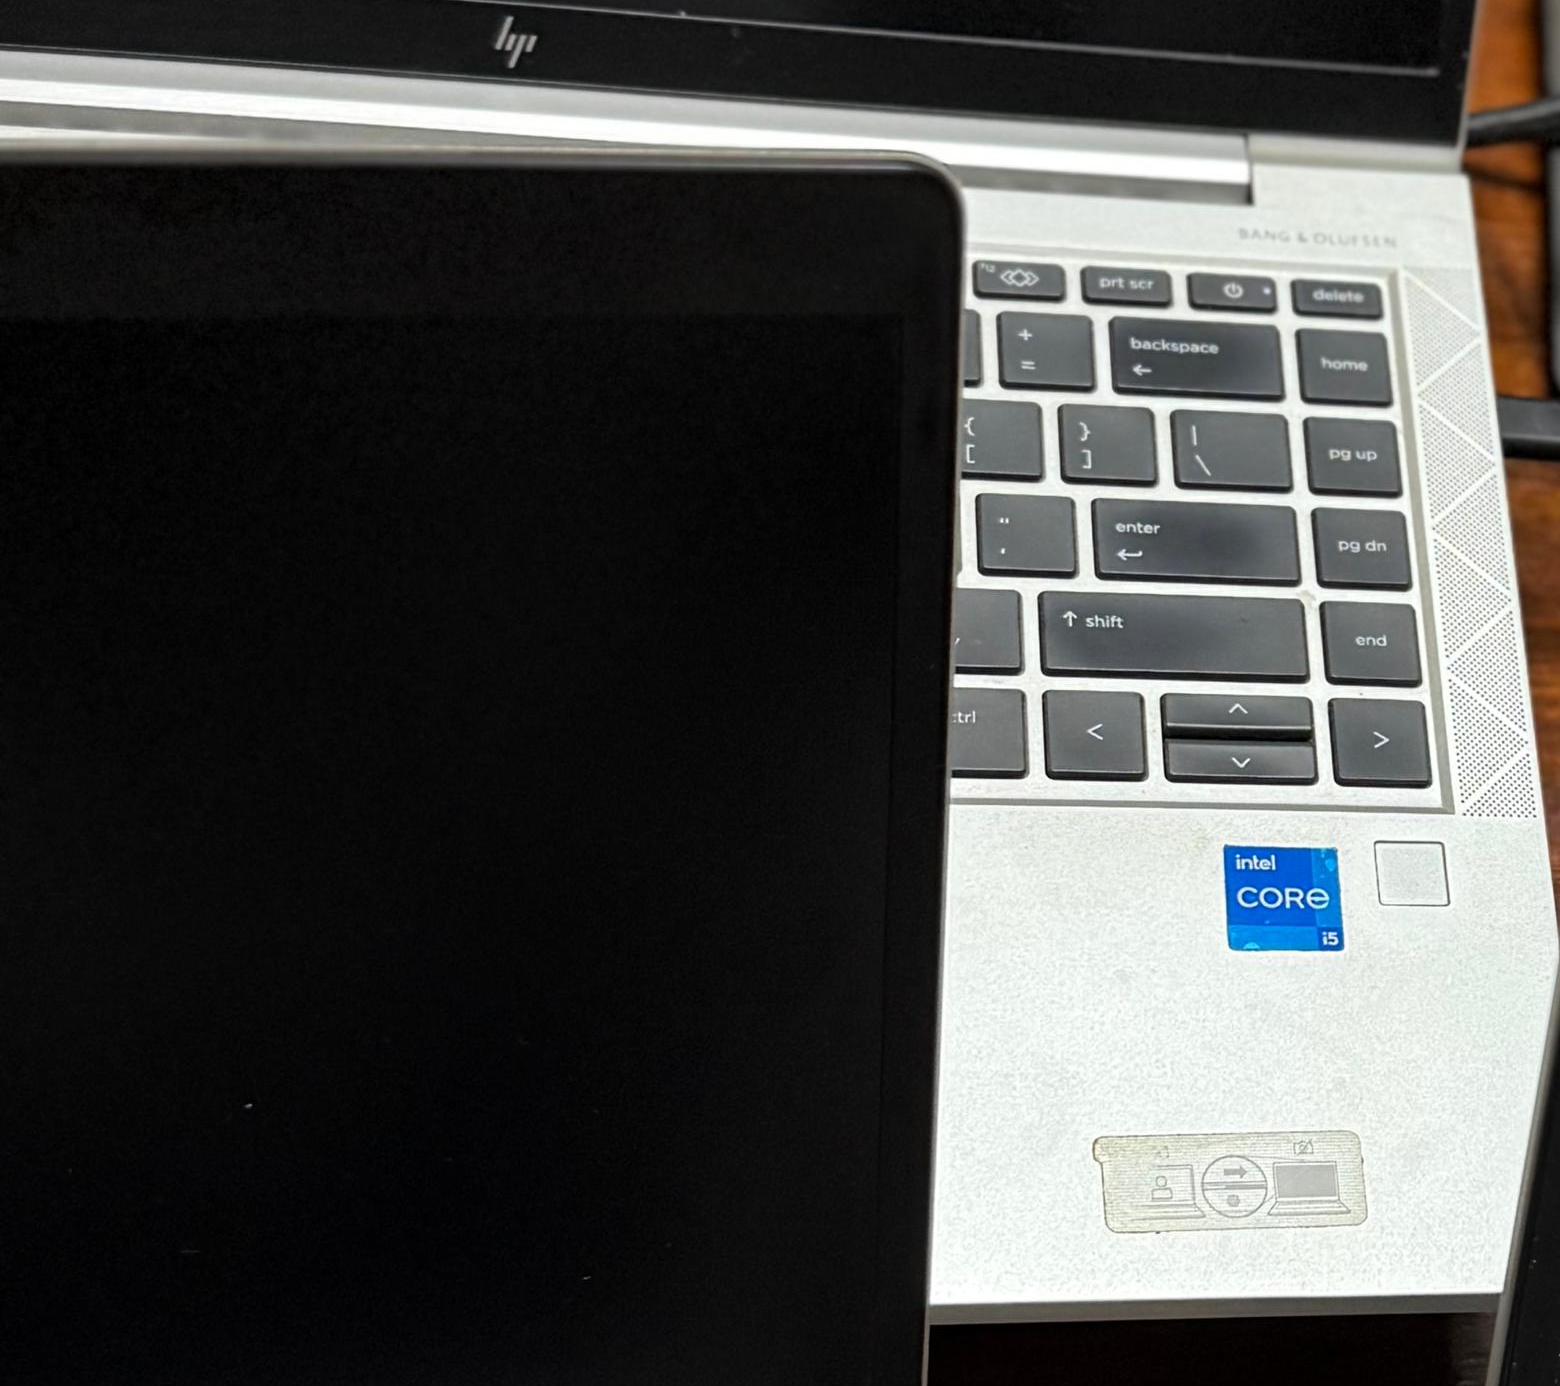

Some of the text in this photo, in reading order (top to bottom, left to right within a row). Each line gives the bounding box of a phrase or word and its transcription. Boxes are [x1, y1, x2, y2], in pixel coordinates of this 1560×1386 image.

[493, 15, 538, 69] hp
[1238, 228, 1290, 242] BANG
[1313, 233, 1397, 248] OLUFSEN
[1099, 277, 1154, 290] prt scr
[1312, 289, 1364, 303] delete
[1129, 336, 1219, 355] backspace
[1320, 357, 1369, 372] home
[1328, 449, 1378, 462] pg up
[1115, 522, 1161, 534] enter
[1338, 539, 1387, 553] pg dn
[1085, 614, 1124, 629] shift
[1355, 634, 1388, 647] end
[1235, 854, 1276, 871] intel
[1322, 931, 1339, 946] i5
